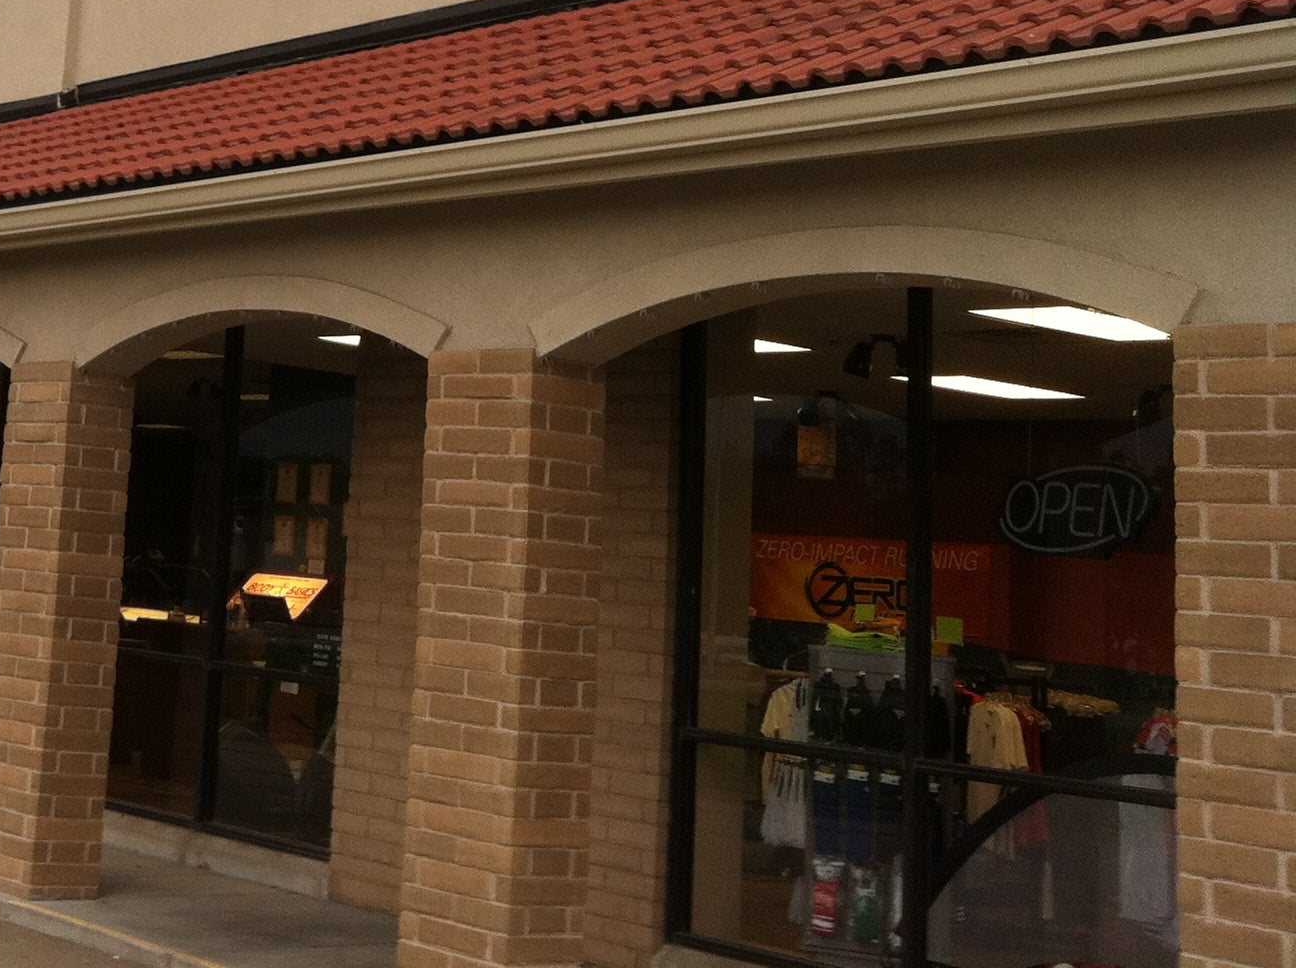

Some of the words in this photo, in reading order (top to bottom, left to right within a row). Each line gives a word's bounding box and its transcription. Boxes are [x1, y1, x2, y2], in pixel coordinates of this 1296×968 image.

[1005, 479, 1136, 539] OPEN
[756, 539, 882, 564] ZERO-IMPACT
[884, 545, 978, 571] RUNING
